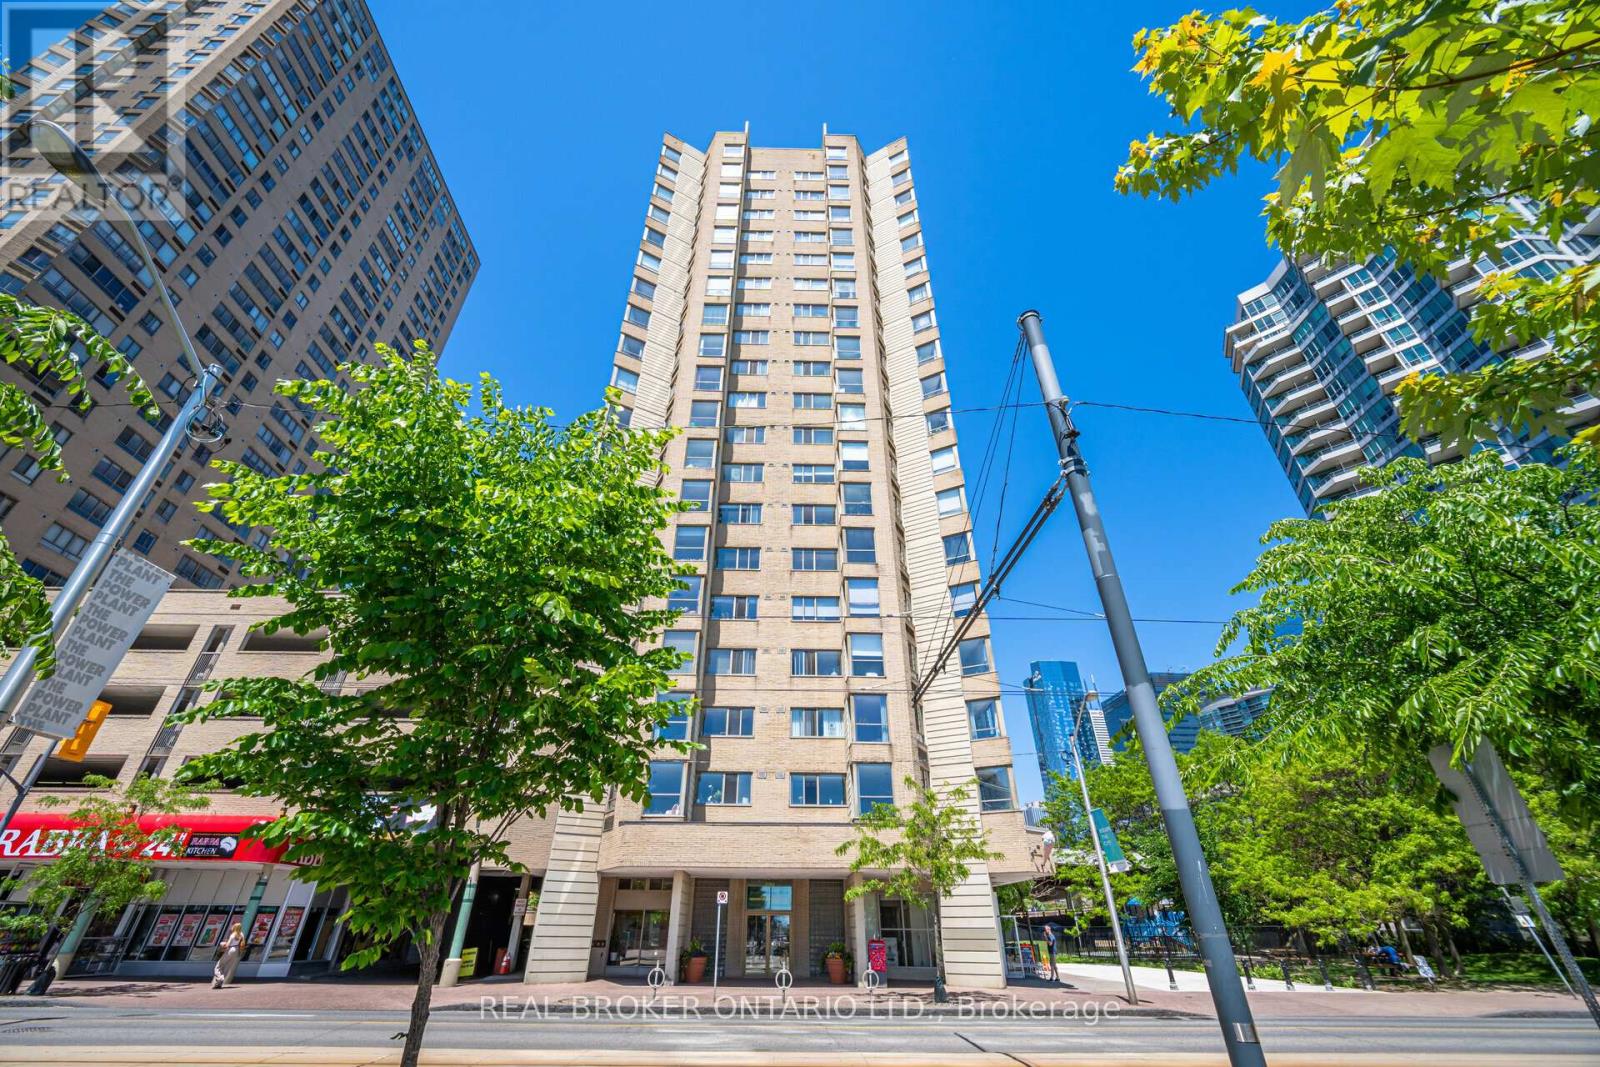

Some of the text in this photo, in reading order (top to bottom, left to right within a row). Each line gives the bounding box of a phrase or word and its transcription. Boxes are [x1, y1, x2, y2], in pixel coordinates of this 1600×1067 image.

[108, 569, 136, 588] THE
[114, 556, 162, 584] PLANT
[94, 591, 140, 617] PLANT
[100, 580, 150, 609] POWER
[87, 603, 113, 621] THE
[72, 625, 119, 651] PLANT
[79, 614, 129, 642] POWER
[65, 638, 89, 656] THE
[59, 650, 106, 677] POWER
[23, 702, 71, 725] PLANT
[31, 689, 83, 714] POWER
[187, 847, 217, 855] KITCHEN
